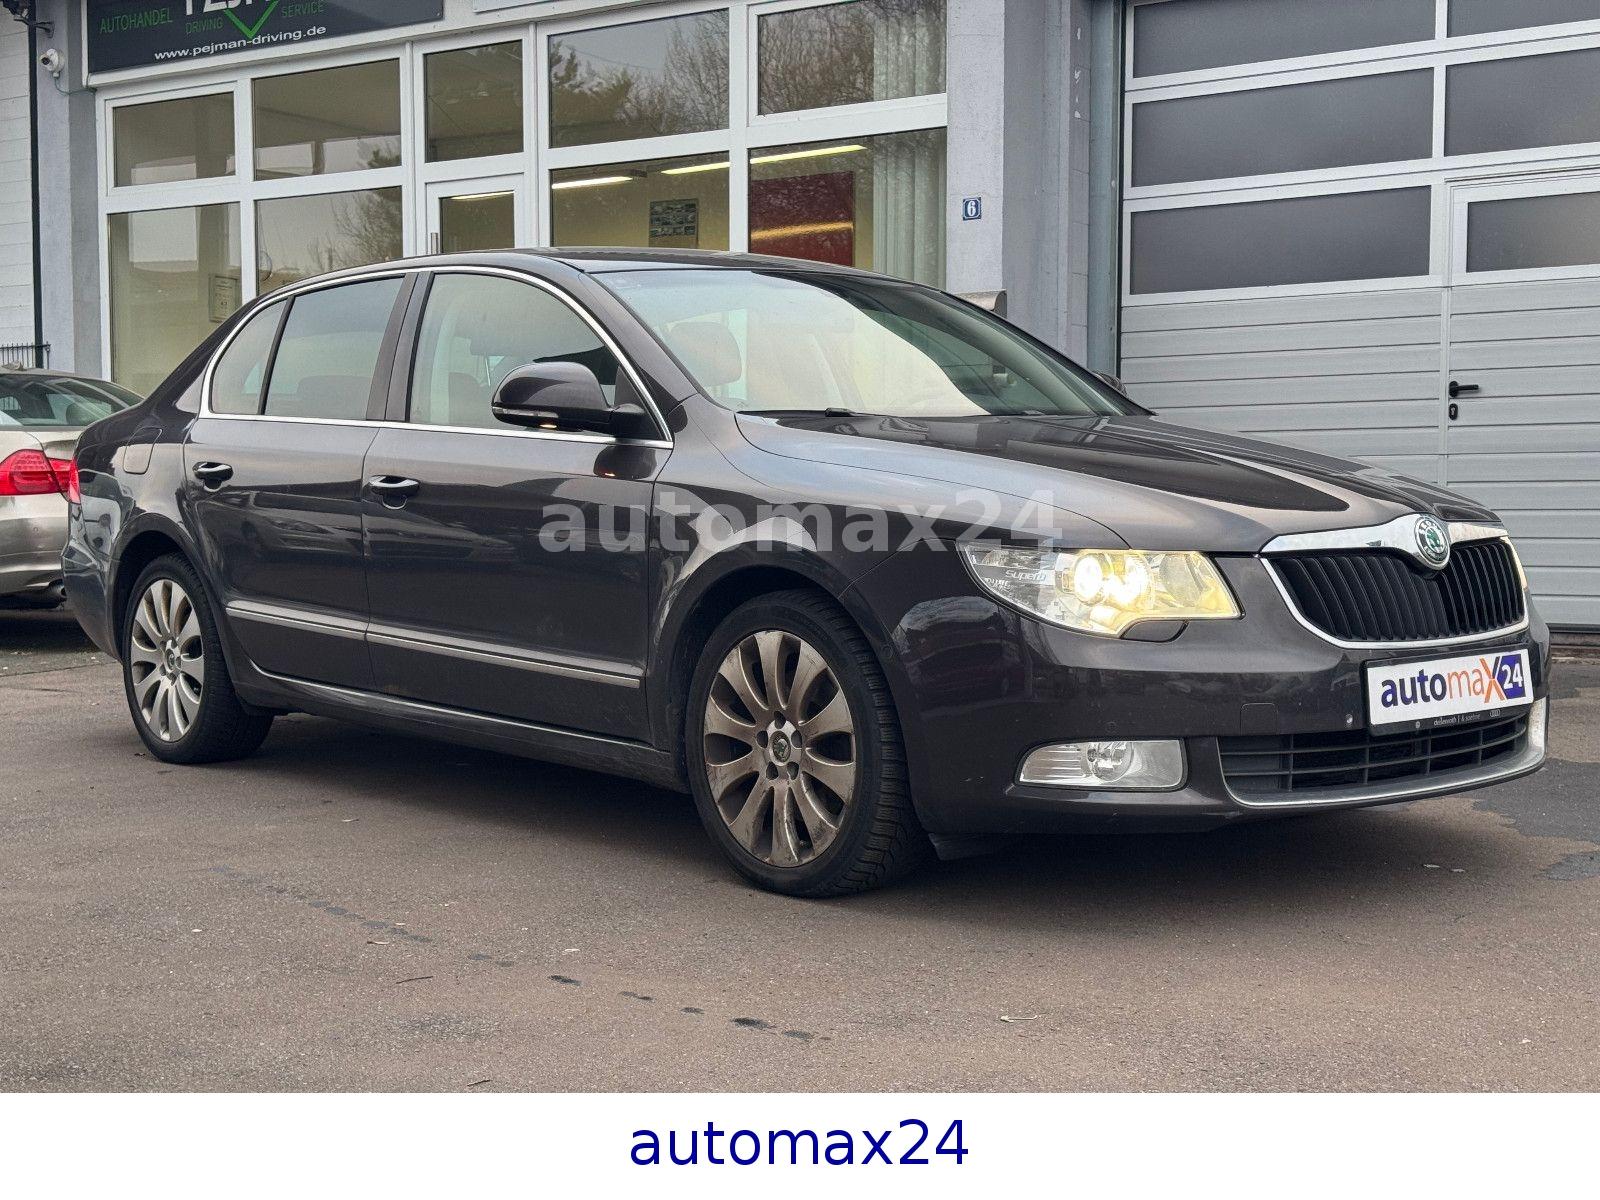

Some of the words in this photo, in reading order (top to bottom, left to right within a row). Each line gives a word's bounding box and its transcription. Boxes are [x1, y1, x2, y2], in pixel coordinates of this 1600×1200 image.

[281, 1, 325, 18] SERVICE
[100, 8, 174, 34] AUTOHANDEL
[185, 17, 224, 34] DRIVING
[154, 25, 327, 60] www.pejman-driving.de
[967, 200, 977, 217] 6
